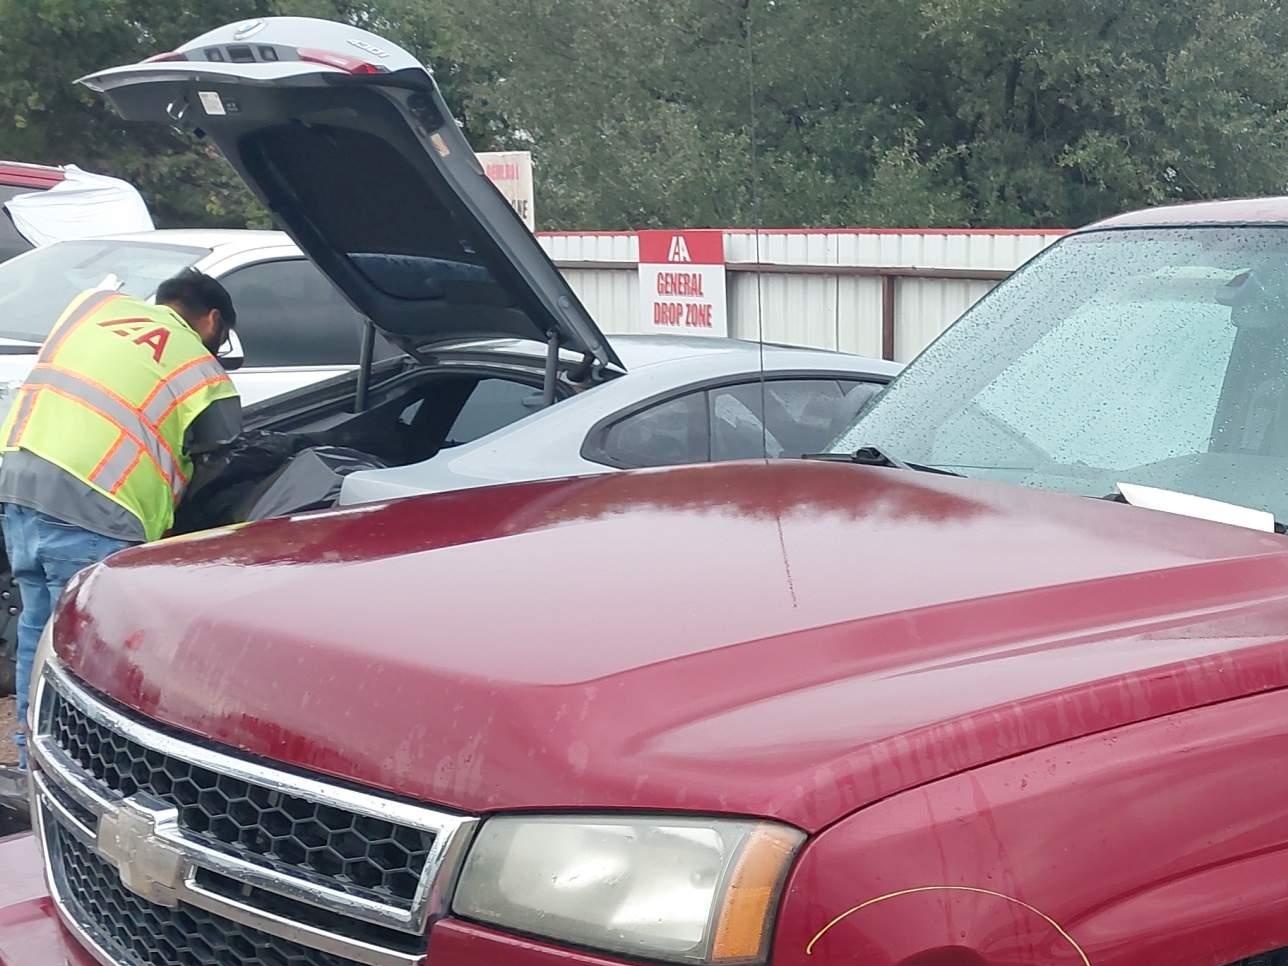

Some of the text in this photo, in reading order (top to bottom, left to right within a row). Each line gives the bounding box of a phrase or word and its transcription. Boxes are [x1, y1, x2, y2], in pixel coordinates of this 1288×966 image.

[657, 272, 703, 296] GENERAL
[654, 302, 712, 327] DROP ZONE
